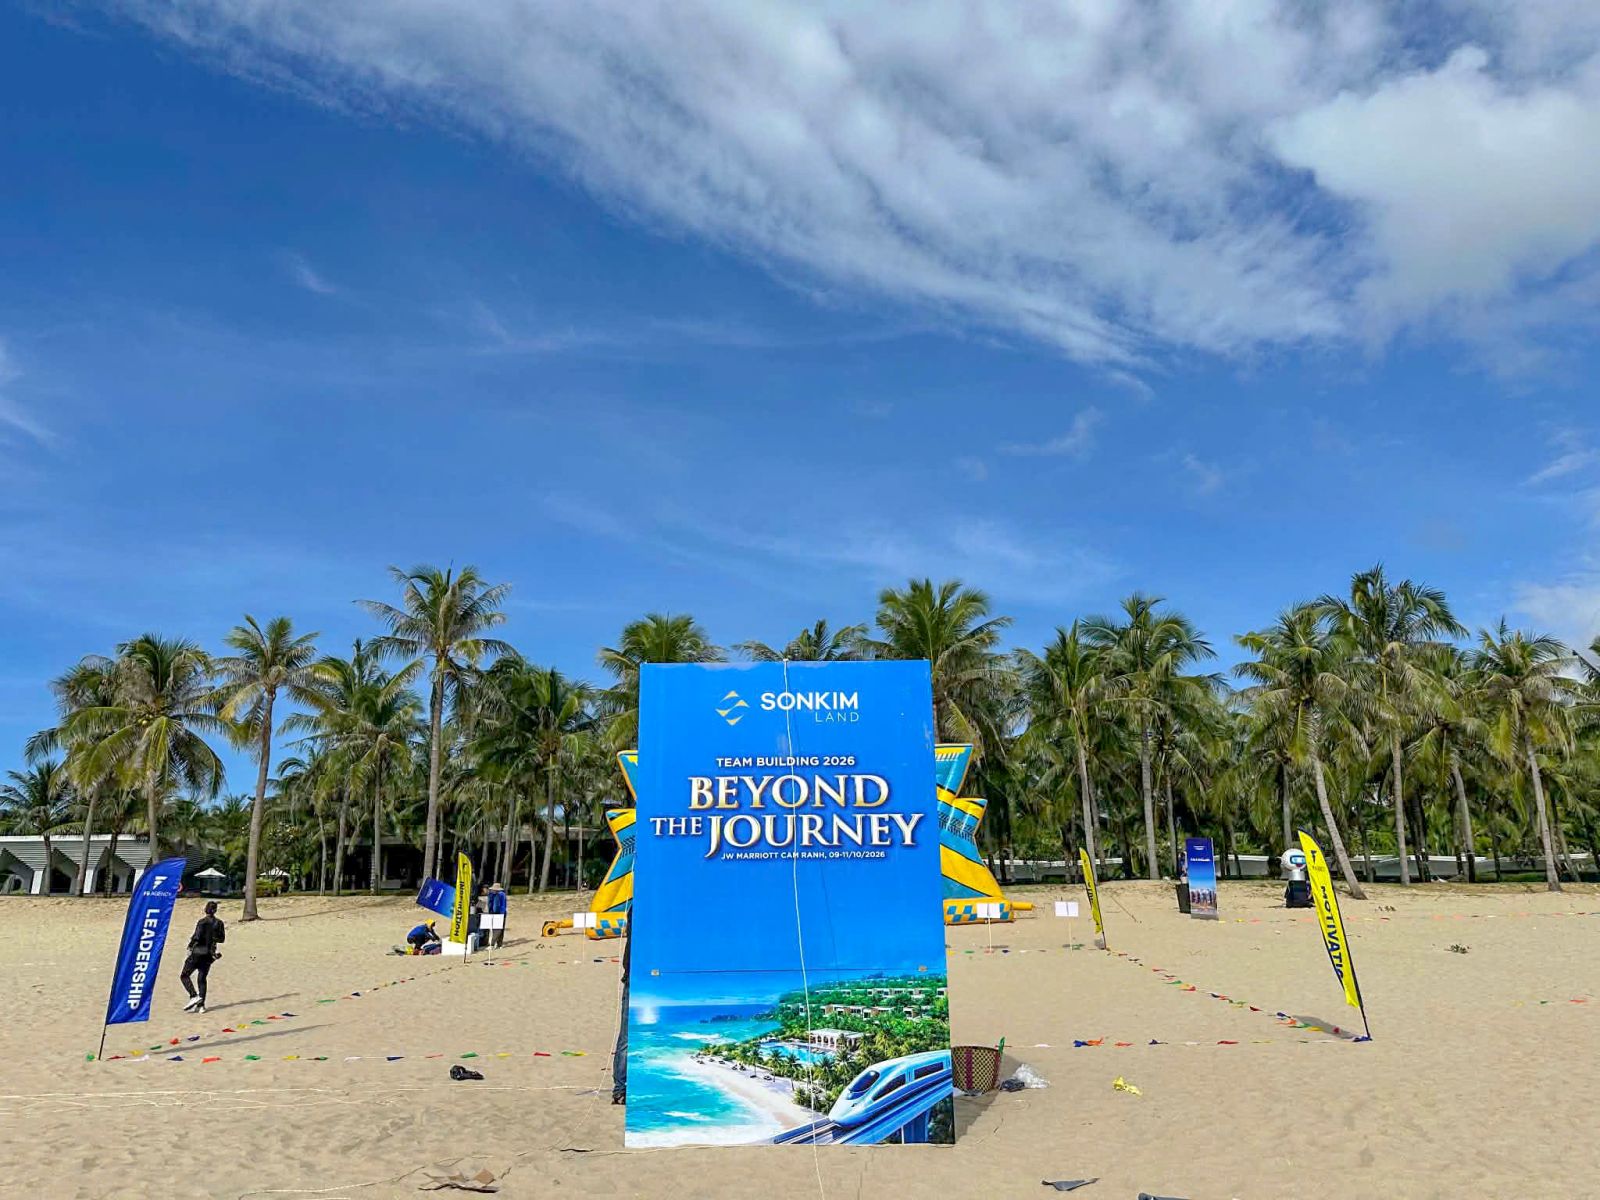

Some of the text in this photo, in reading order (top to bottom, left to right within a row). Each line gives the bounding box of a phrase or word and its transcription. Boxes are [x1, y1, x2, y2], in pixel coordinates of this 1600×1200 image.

[760, 691, 859, 711] SONKIM
[815, 711, 860, 723] LAND
[716, 755, 856, 767] TEAM BUILDING 2026
[688, 774, 889, 810] BEYOND
[649, 812, 924, 858] THE JOURNEY
[736, 852, 779, 860] MARRIOTT
[781, 852, 799, 860] CAM
[801, 851, 827, 860] RANH,
[828, 850, 886, 859] 09-11/10/2026
[127, 908, 160, 1011] LEADERSHIP
